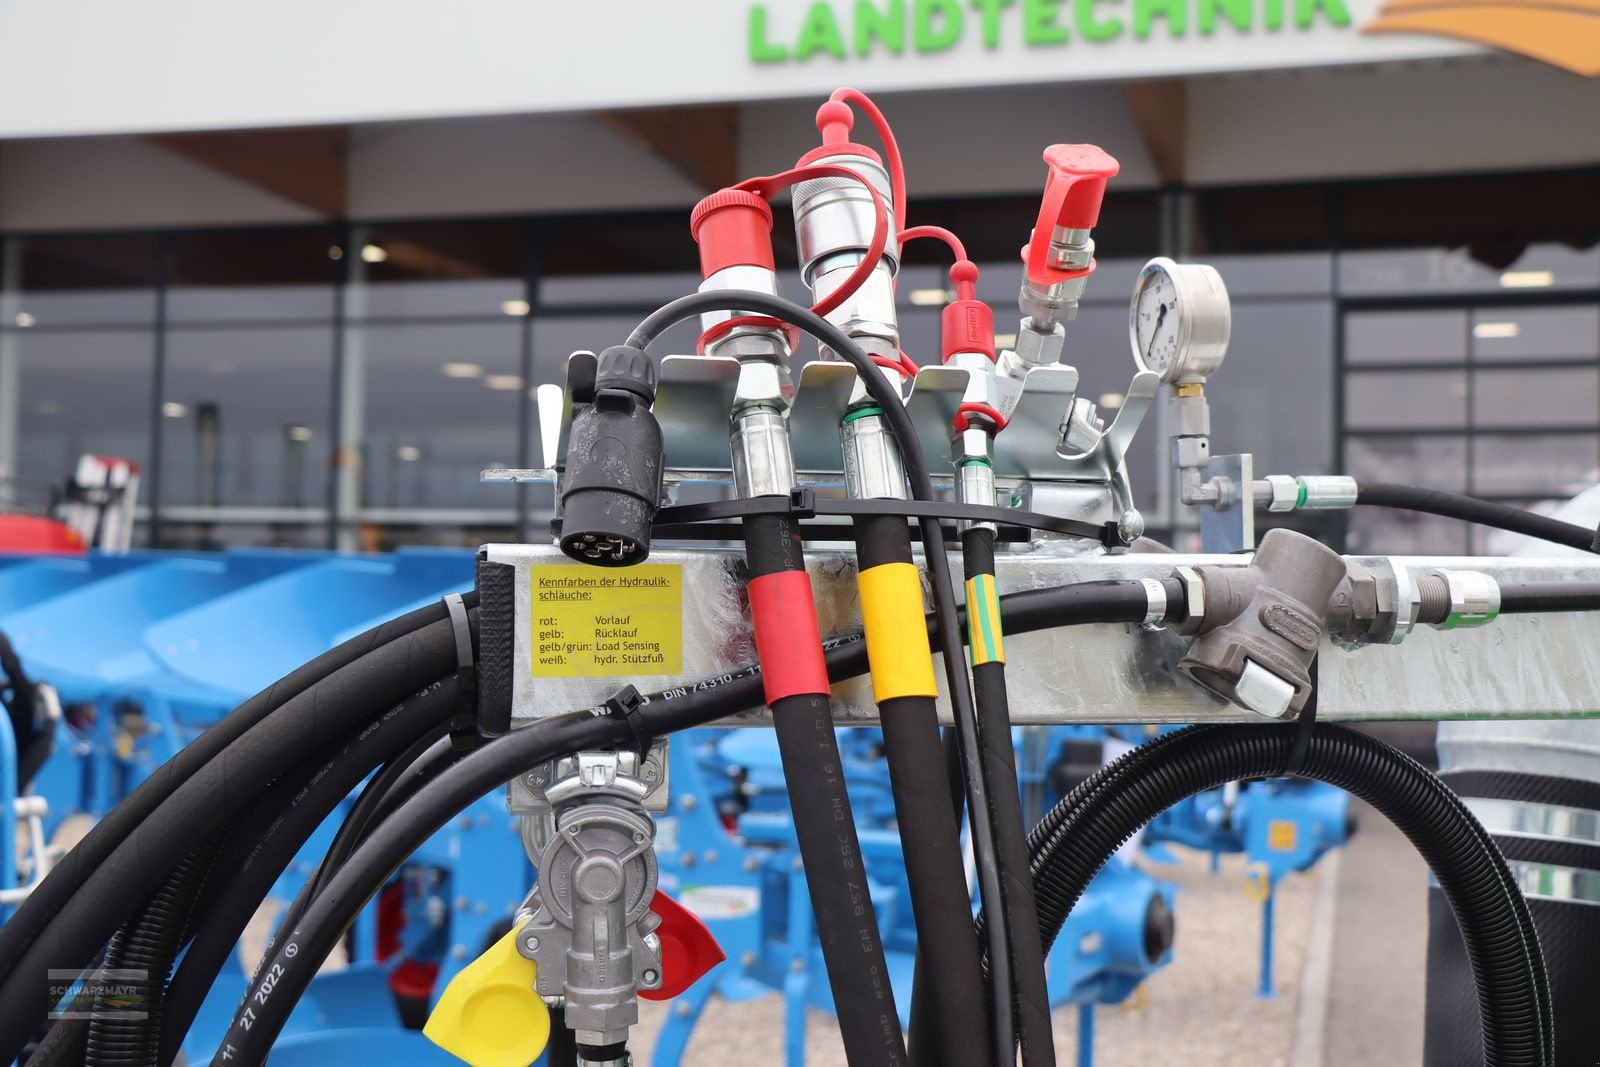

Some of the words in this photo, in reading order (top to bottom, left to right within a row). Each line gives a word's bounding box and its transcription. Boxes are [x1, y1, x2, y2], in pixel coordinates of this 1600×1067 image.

[539, 577, 596, 587] Kennfarben
[600, 577, 616, 586] der
[619, 577, 670, 588] Hydraulik-
[539, 591, 592, 600] schläuche:
[539, 617, 558, 626] rot:
[595, 616, 631, 625] Vorlauf
[539, 630, 564, 641] gelb:
[595, 628, 638, 638] Rücklauf
[539, 642, 592, 654] gelb/grün:
[596, 642, 619, 651] Load
[623, 641, 660, 651] Sensing
[539, 655, 567, 665] weiß:
[594, 655, 618, 666] hydr.
[622, 653, 664, 664] Stützfuß
[663, 687, 688, 701] DIN
[691, 674, 732, 693] 74310
[239, 1007, 257, 1031] 27
[254, 963, 286, 1006] 2022
